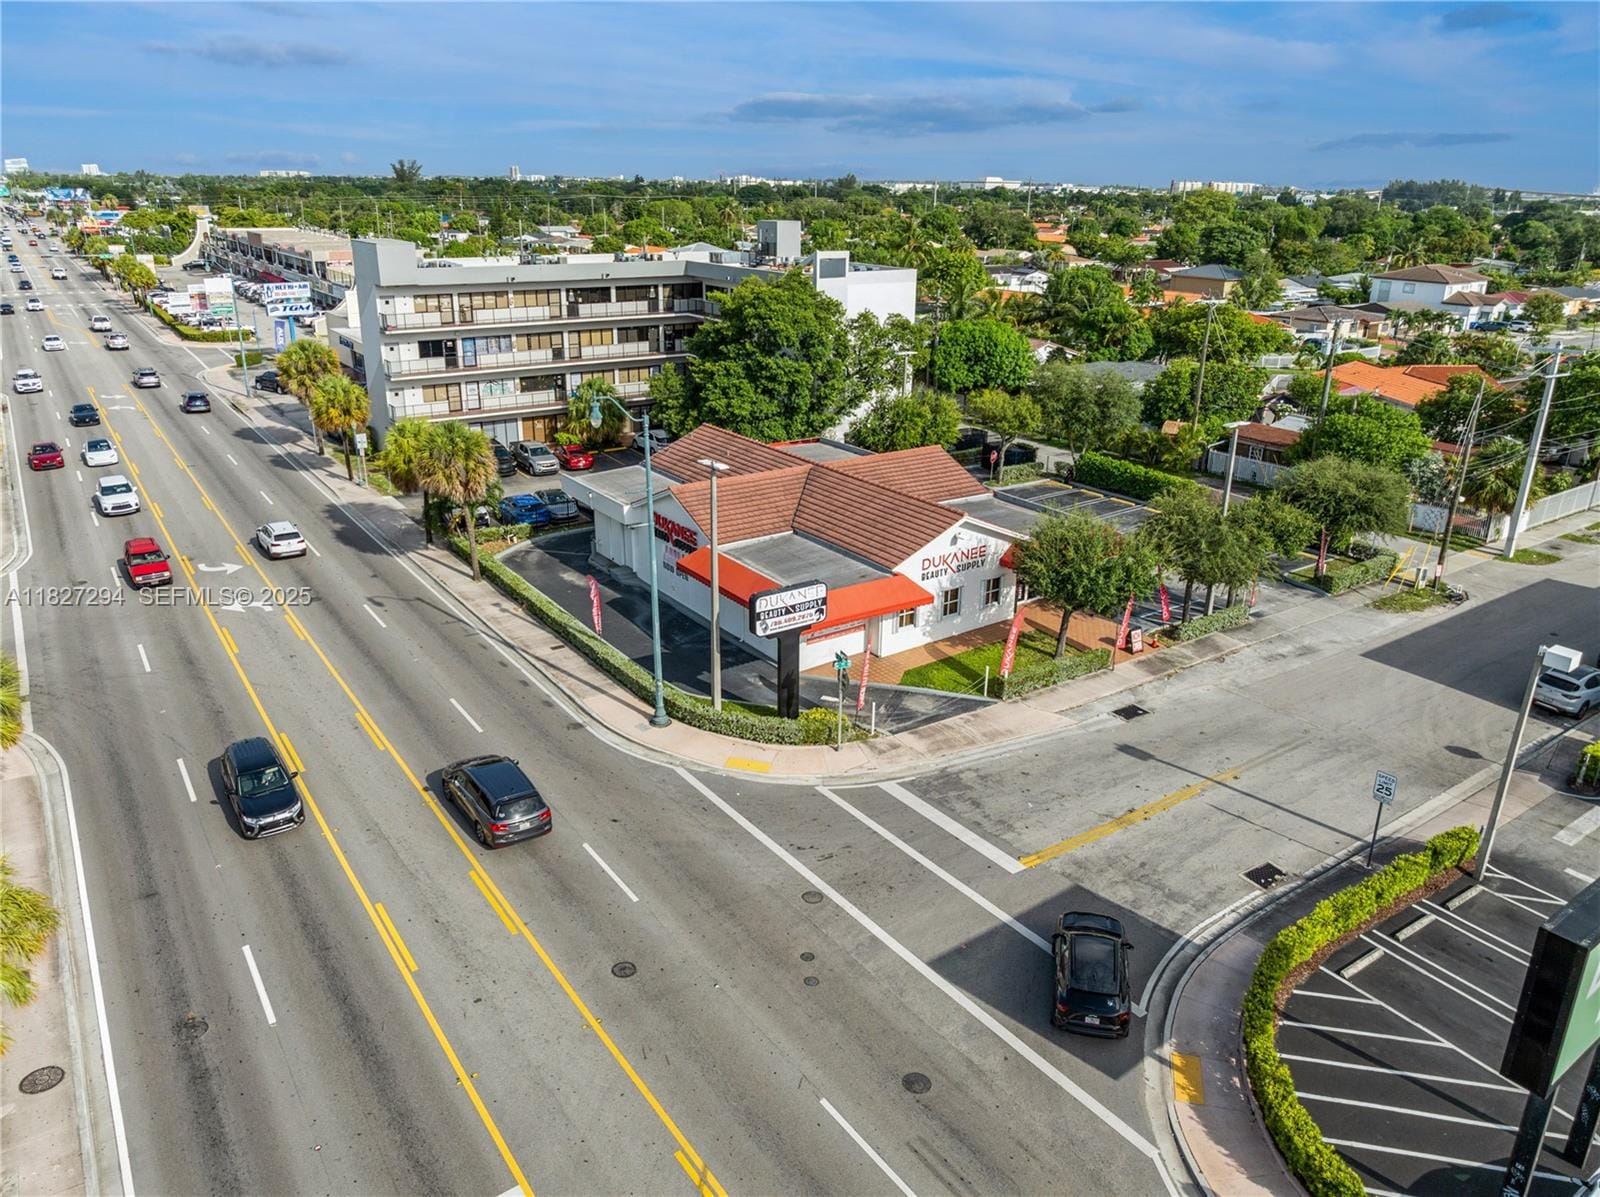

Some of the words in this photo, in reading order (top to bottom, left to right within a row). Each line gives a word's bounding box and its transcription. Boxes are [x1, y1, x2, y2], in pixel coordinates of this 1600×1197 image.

[283, 304, 311, 312] TGM
[922, 545, 987, 573] DUKANEE
[921, 568, 949, 581] BEAUTY
[956, 559, 986, 574] SUPPLY
[760, 607, 786, 621] BEAUTY
[795, 599, 823, 613] SUPPLY
[1378, 773, 1396, 783] SPEED
[1379, 779, 1393, 787] LIMIT
[1376, 783, 1393, 797] 25
